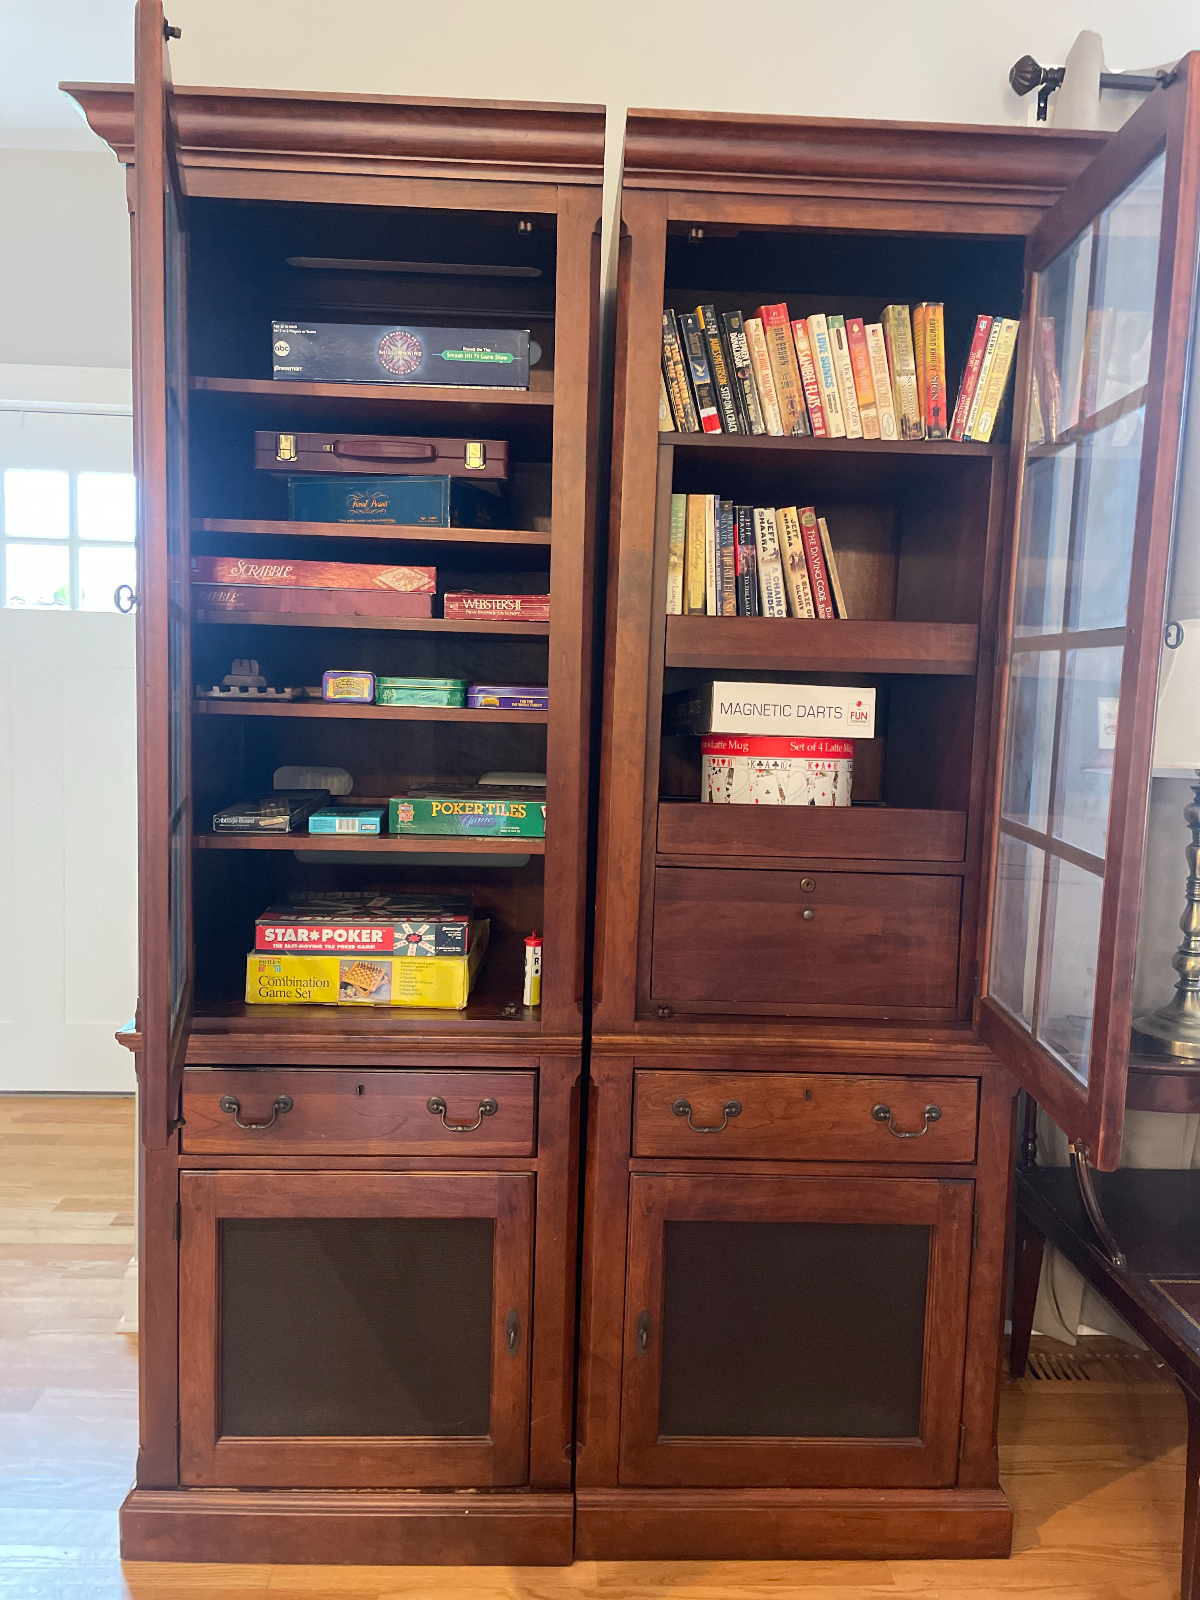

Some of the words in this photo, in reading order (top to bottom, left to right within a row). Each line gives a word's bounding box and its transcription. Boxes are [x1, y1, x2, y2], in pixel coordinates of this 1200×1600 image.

[774, 328, 786, 341] DAN
[929, 318, 938, 346] RAYMOND
[274, 344, 290, 353] abc
[378, 349, 423, 357] MILLIONAIRE
[688, 332, 702, 357] Sanctuary
[709, 338, 722, 355] JAMES
[729, 332, 743, 368] DONALDSON
[737, 333, 750, 359] STEPHEN
[816, 332, 829, 354] LOVE
[446, 351, 464, 359] Smash
[480, 353, 494, 361] Game
[776, 343, 790, 366] BROWN
[929, 348, 938, 371] KHOURY
[713, 355, 728, 385] PATTERSON
[798, 351, 816, 384] SANIBEL
[820, 356, 835, 389] SONGS
[721, 387, 731, 400] STEP
[803, 384, 822, 409] FLATS
[842, 363, 853, 383] Uncle
[849, 406, 860, 427] Cabin
[930, 376, 940, 401] SIGN
[723, 400, 733, 410] ON
[726, 414, 738, 433] CRACK
[719, 513, 729, 546] SHAARA
[739, 510, 747, 545] SHAARA
[744, 518, 752, 537] JEFF
[758, 511, 769, 553] SHAARA
[766, 519, 776, 544] JEFF
[783, 513, 795, 548] SHAARA
[790, 519, 800, 539] JEFF
[807, 529, 818, 546] THE
[810, 546, 820, 559] DA
[231, 559, 293, 580] SCRABBLE
[812, 558, 824, 579] VINCI
[722, 566, 734, 594] KILLER
[772, 576, 784, 607] CHAIN
[795, 584, 805, 611] GLORY
[801, 580, 812, 608] BLAZE
[816, 579, 828, 603] CODE
[463, 599, 514, 610] WEBSTER'S
[719, 702, 792, 718] MAGNETIC
[796, 704, 843, 720] DARTS
[850, 711, 868, 720] FUN
[711, 741, 727, 750] Latte
[728, 741, 749, 753] Mug
[789, 741, 806, 752] Set
[806, 741, 817, 752] of
[818, 742, 824, 751] 4
[824, 742, 842, 753] Latte
[750, 760, 756, 769] K
[764, 760, 771, 769] A
[431, 801, 484, 817] POKER
[484, 803, 527, 819] TILES
[214, 817, 239, 825] Cribbage
[239, 817, 255, 825] Board
[461, 815, 495, 829] Game
[264, 928, 310, 942] STAR
[321, 928, 384, 943] POKER
[534, 957, 540, 966] R
[258, 975, 330, 988] Combination
[258, 987, 293, 998] Game
[295, 987, 312, 998] Set
